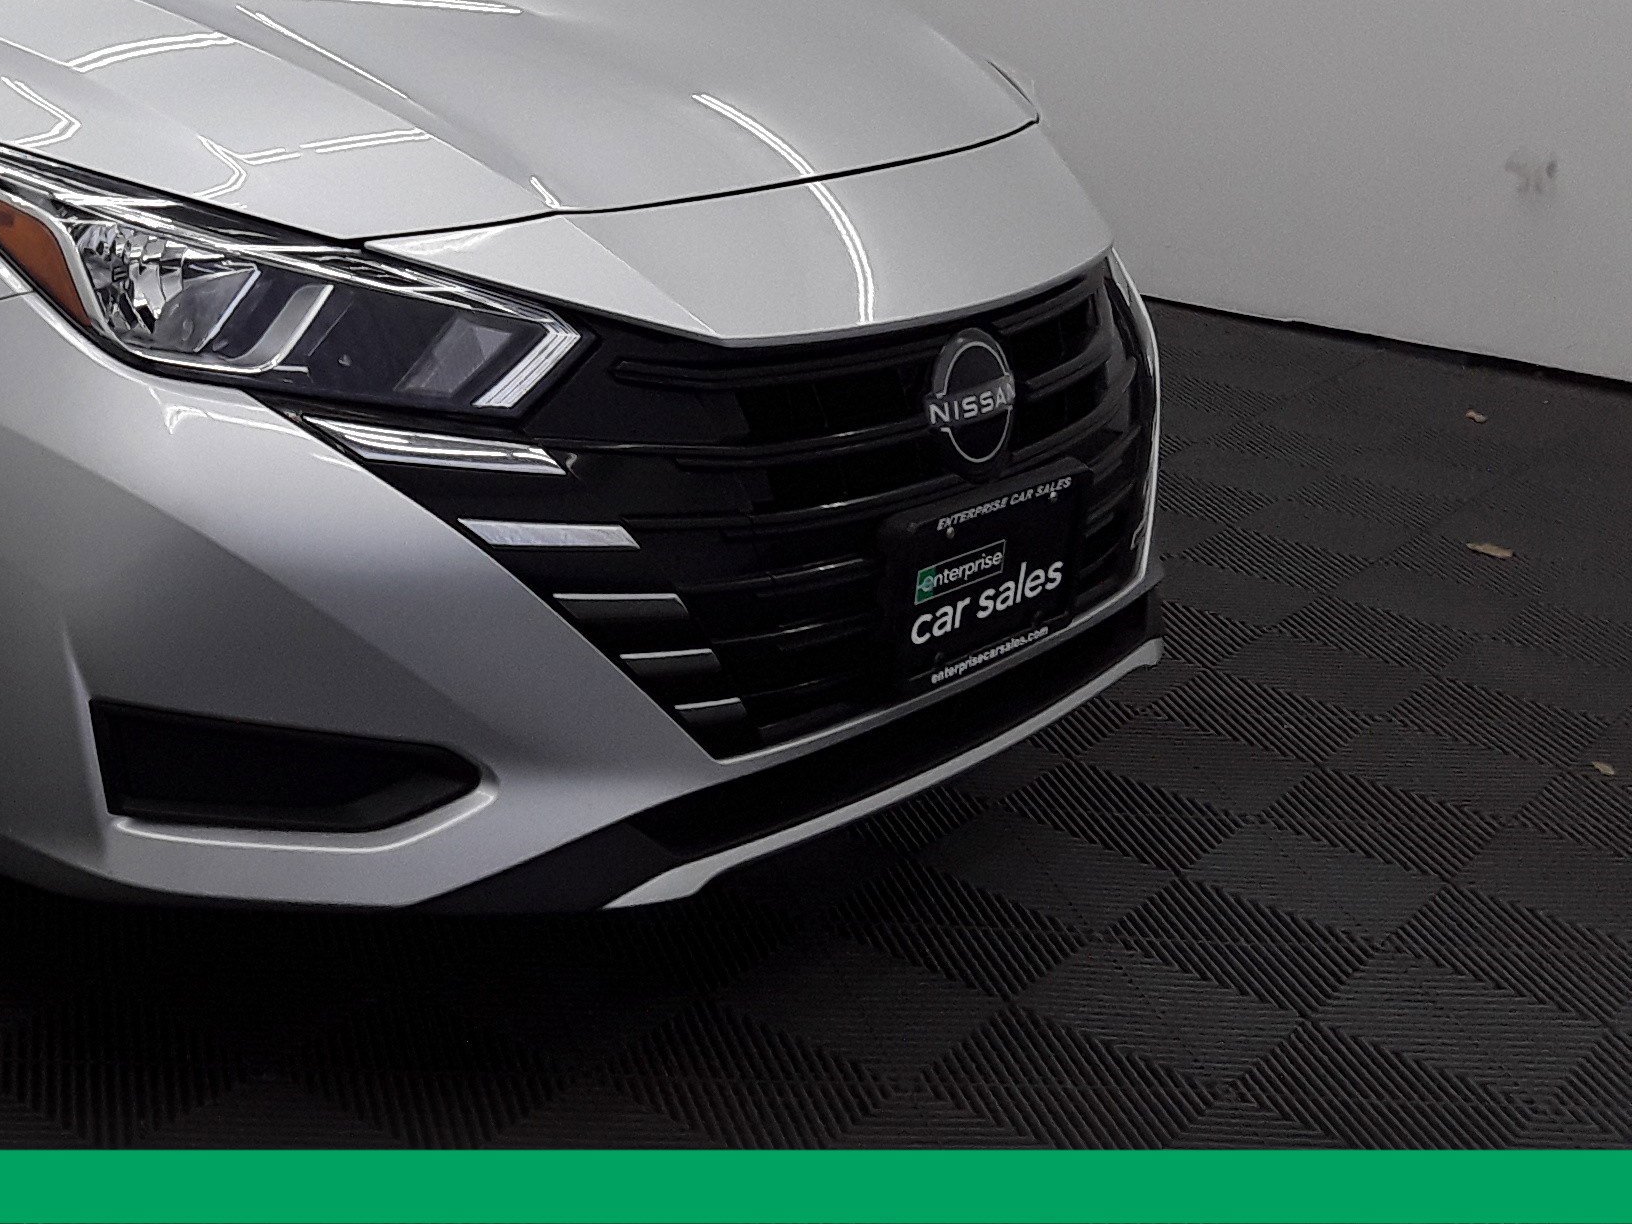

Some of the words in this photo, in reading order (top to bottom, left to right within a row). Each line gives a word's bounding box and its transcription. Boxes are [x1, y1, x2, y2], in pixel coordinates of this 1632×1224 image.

[928, 382, 1016, 425] NISSAN
[936, 497, 1009, 531] ENTERPRISE
[1009, 488, 1034, 506] CAR
[1034, 476, 1072, 498] SALES
[919, 551, 1004, 593] enterprise
[910, 596, 971, 645] car
[976, 560, 1064, 619] sales
[931, 626, 1049, 684] enterprisecarsales.com
